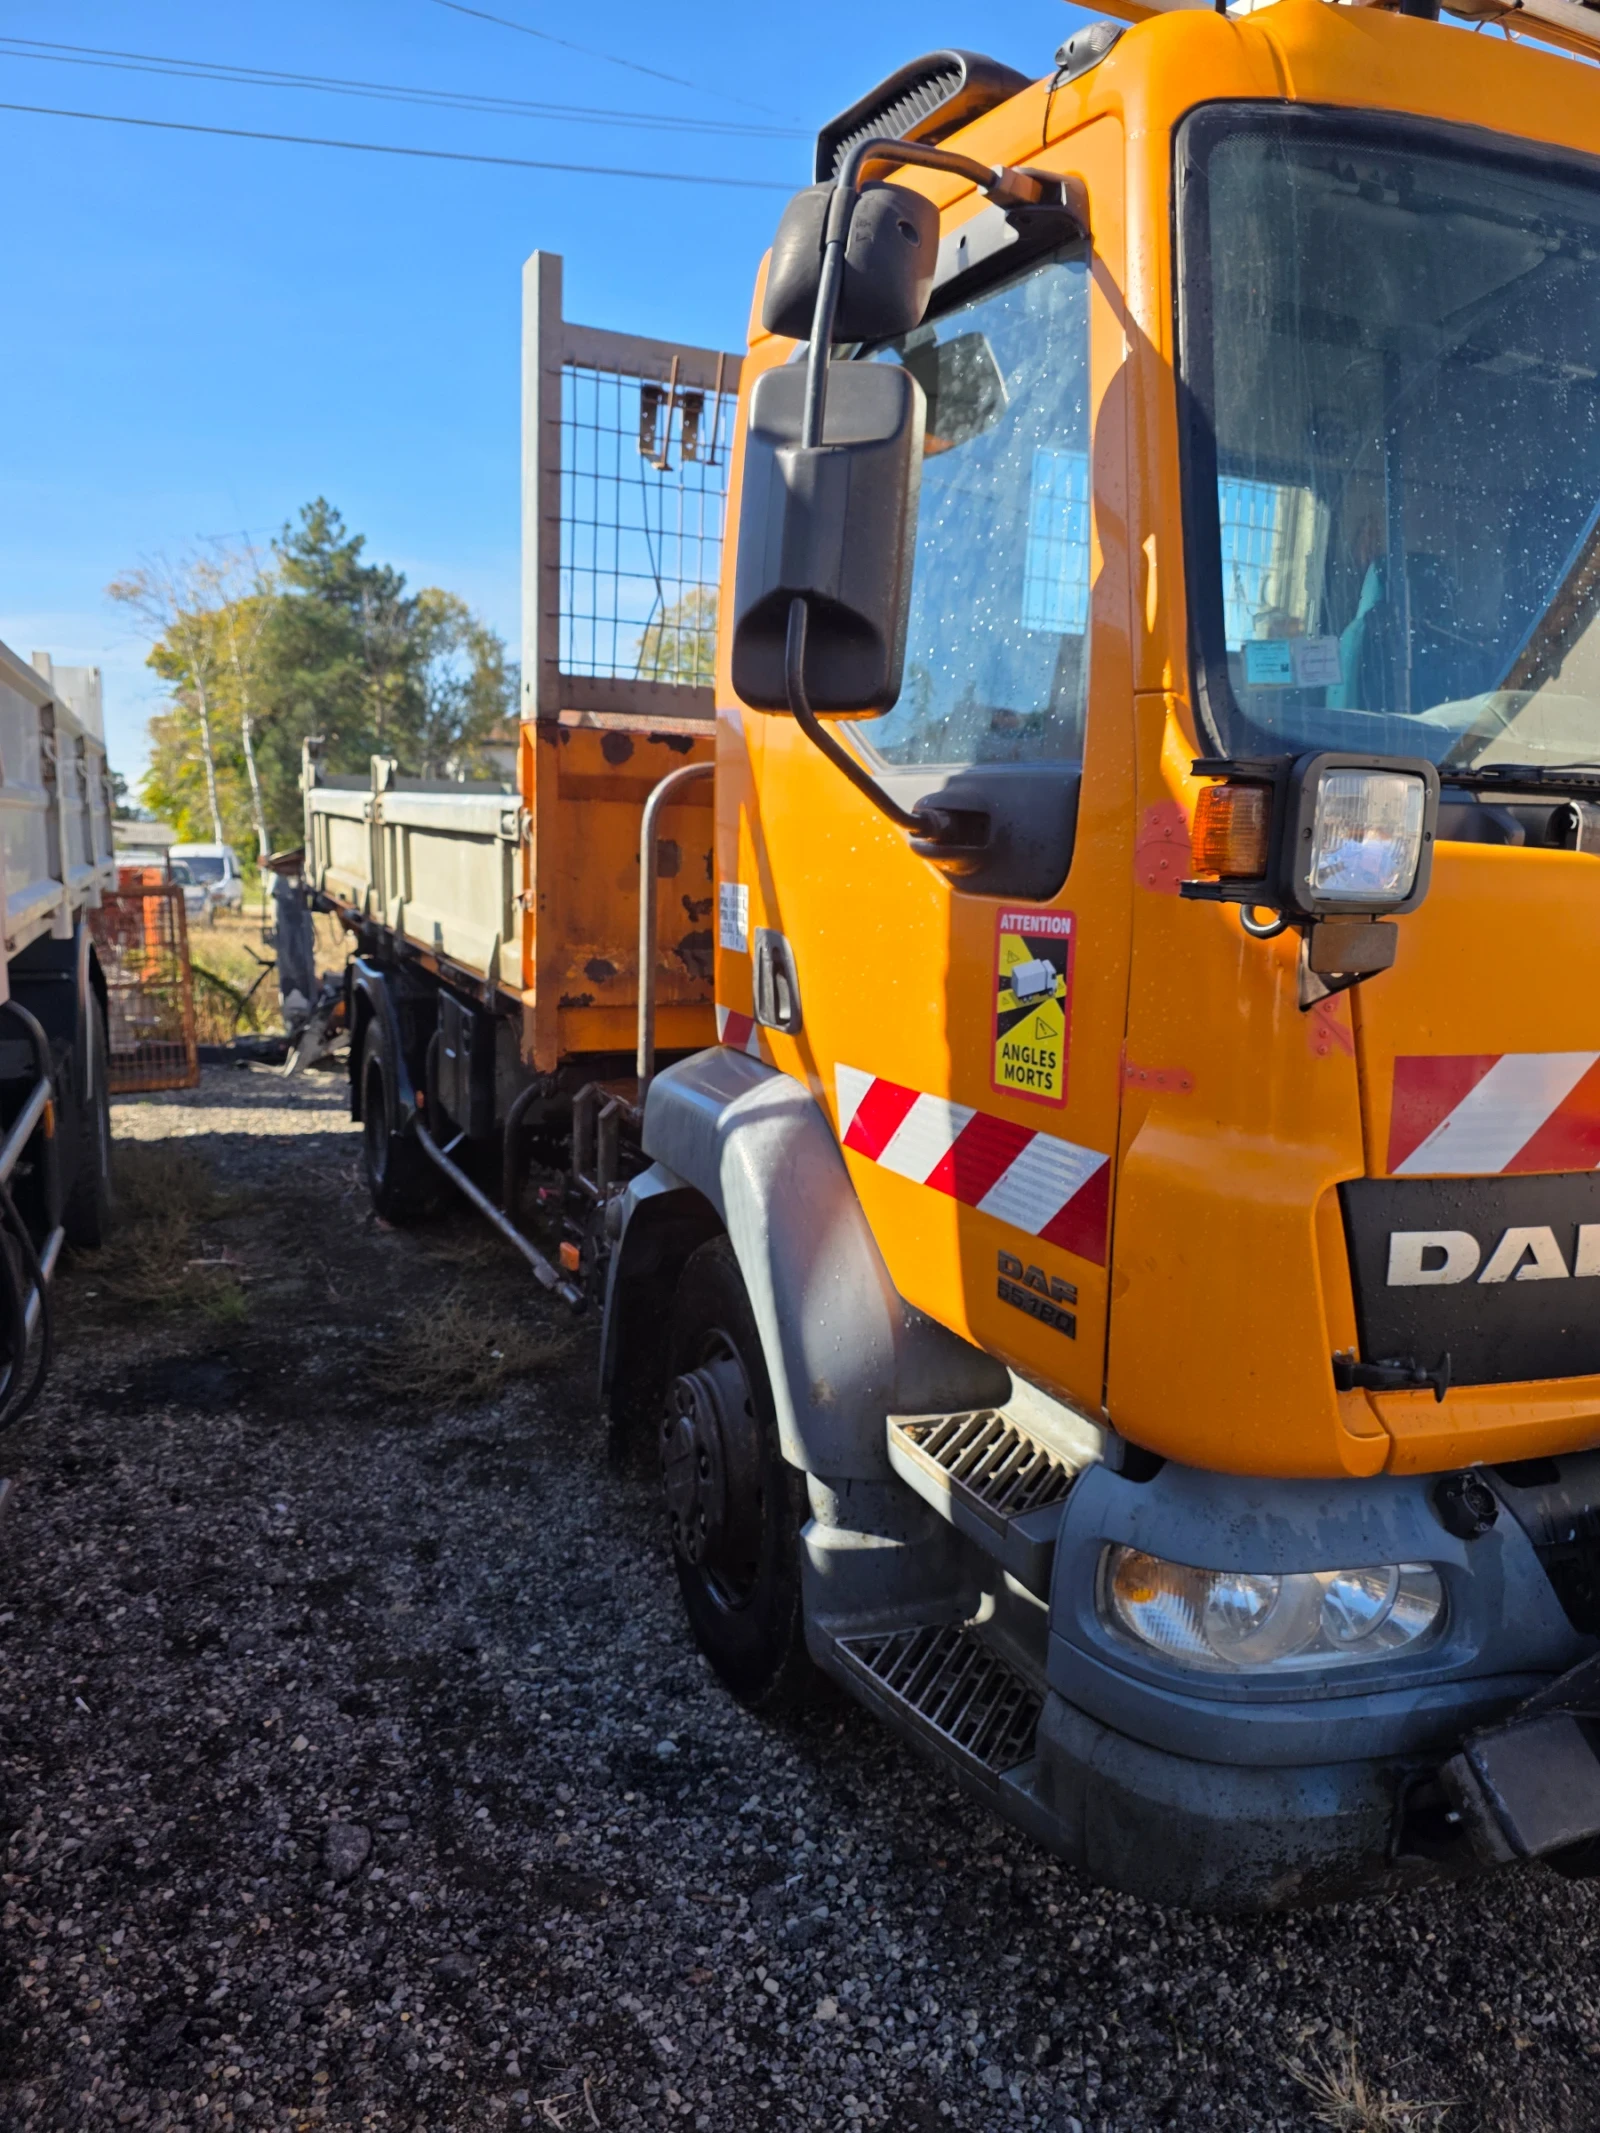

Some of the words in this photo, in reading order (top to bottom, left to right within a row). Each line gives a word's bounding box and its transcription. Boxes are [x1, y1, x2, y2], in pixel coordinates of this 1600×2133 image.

[1000, 914, 1071, 934] ATTENTION
[1002, 1043, 1056, 1069] ANGLES
[1004, 1063, 1053, 1090] MORTS
[997, 1249, 1077, 1305] DAF
